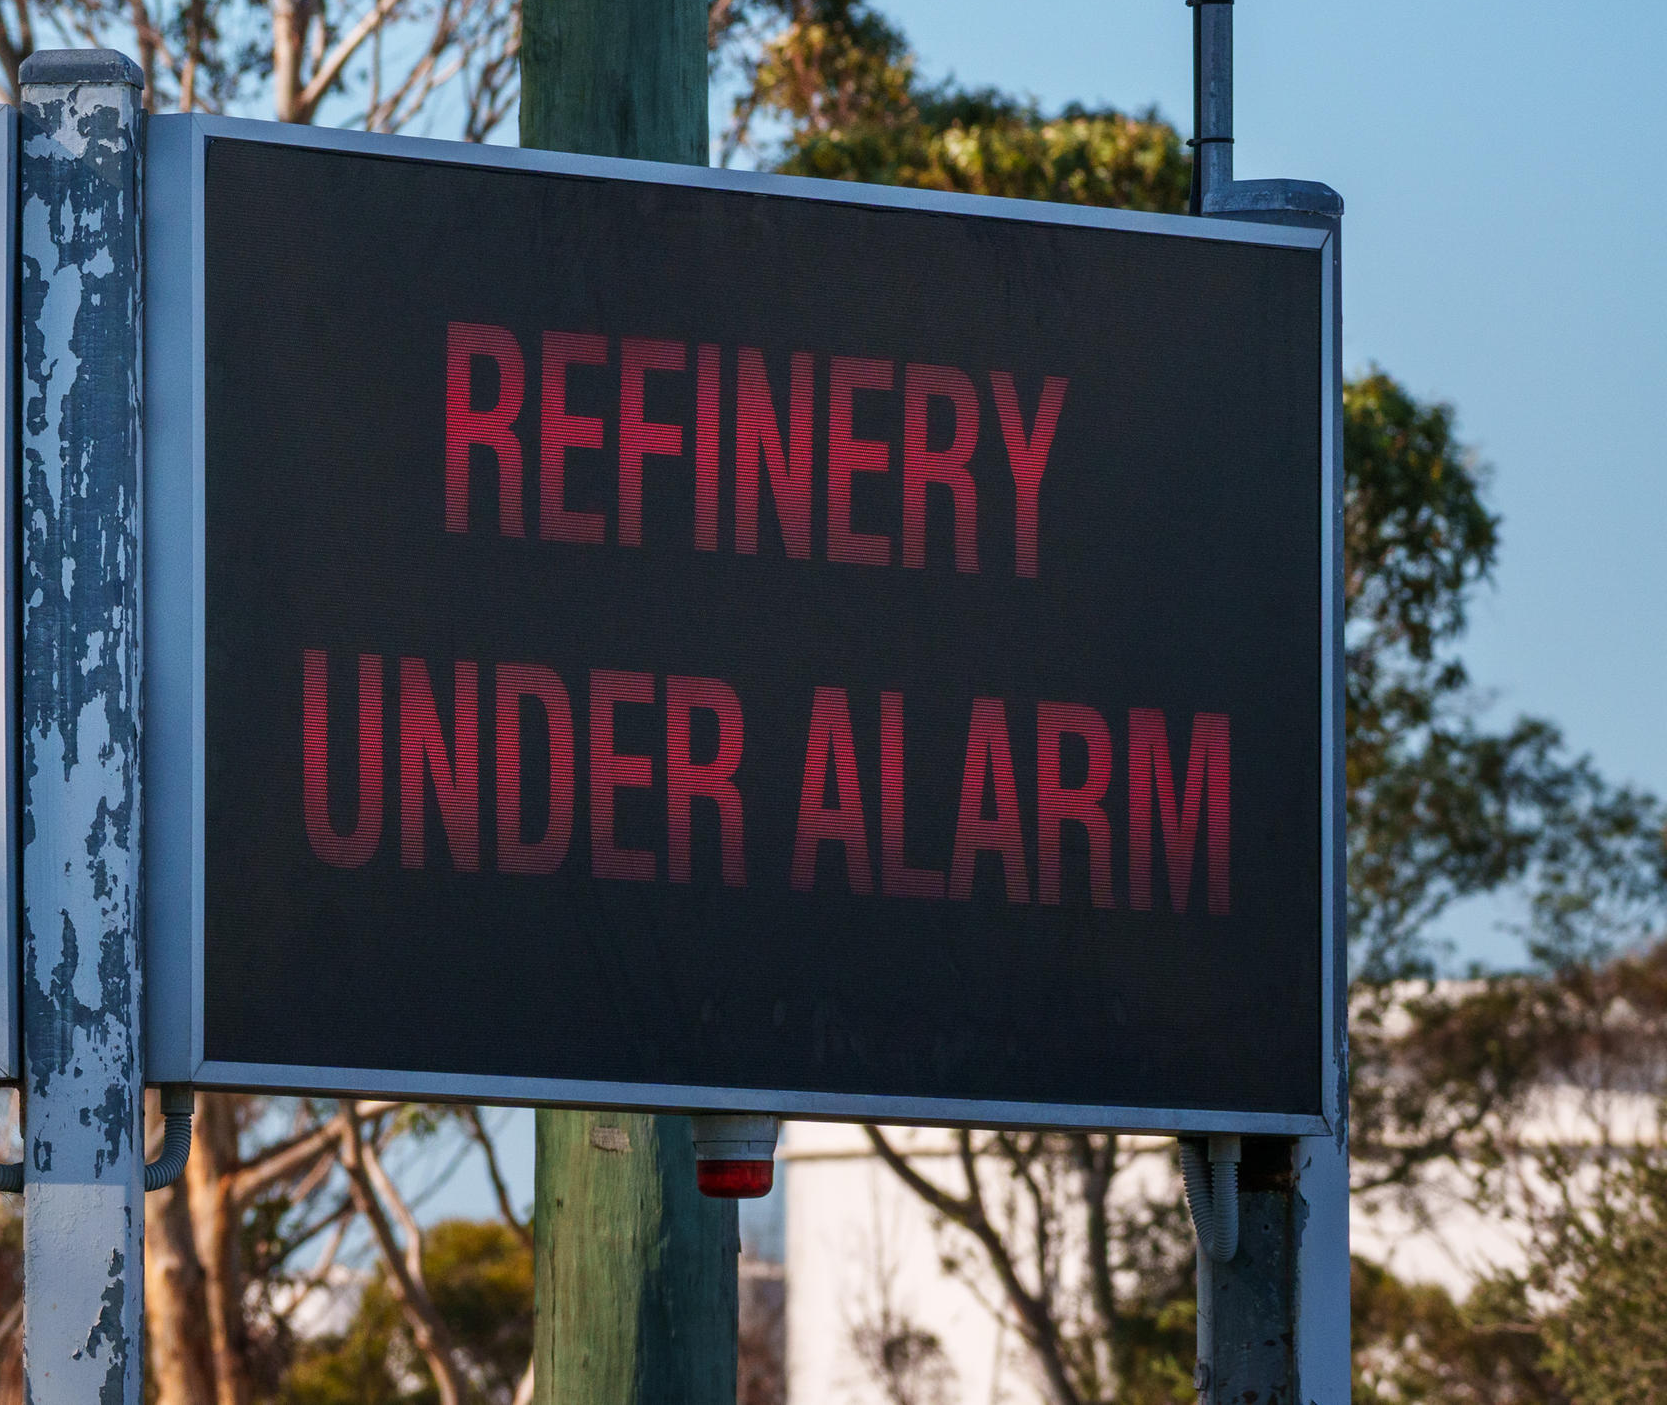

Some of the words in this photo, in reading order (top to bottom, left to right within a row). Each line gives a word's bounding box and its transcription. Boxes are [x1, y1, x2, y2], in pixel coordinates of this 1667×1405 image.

[444, 320, 1069, 579] REFINERY
[302, 649, 748, 887] UNDER
[789, 686, 1231, 915] ALARM
